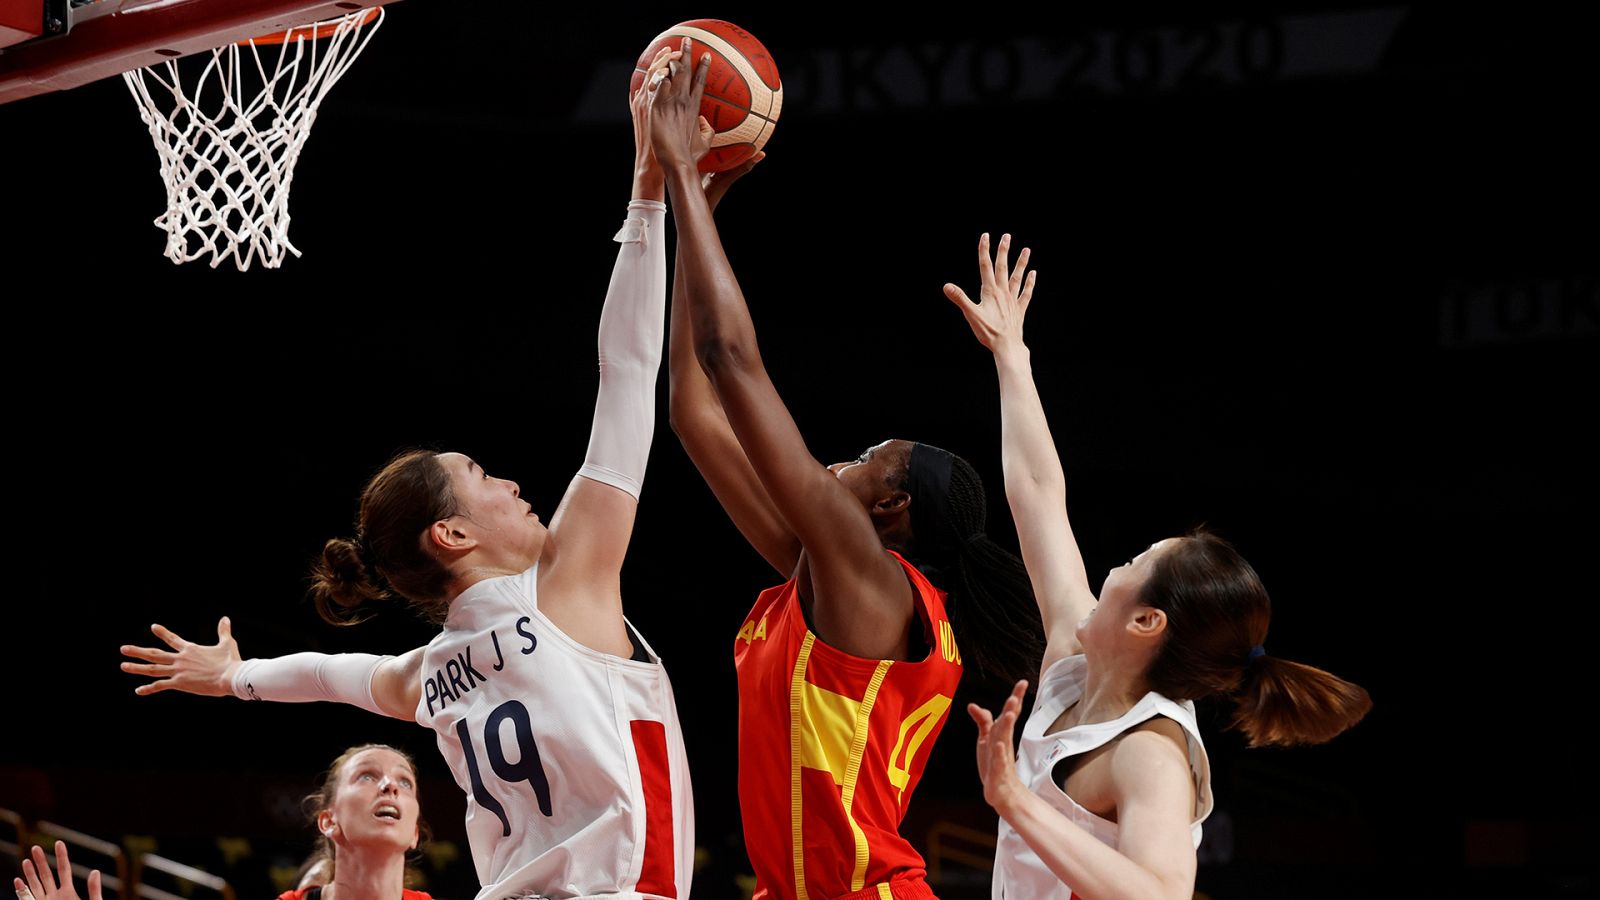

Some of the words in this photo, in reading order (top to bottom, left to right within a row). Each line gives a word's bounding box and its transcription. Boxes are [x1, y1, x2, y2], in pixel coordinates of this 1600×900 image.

[775, 40, 1021, 113] OKYO
[1040, 18, 1282, 98] 2020
[425, 645, 487, 717] PARK
[491, 630, 504, 671] J
[516, 616, 537, 655] S
[456, 700, 552, 837] 19
[888, 693, 953, 807] 4
